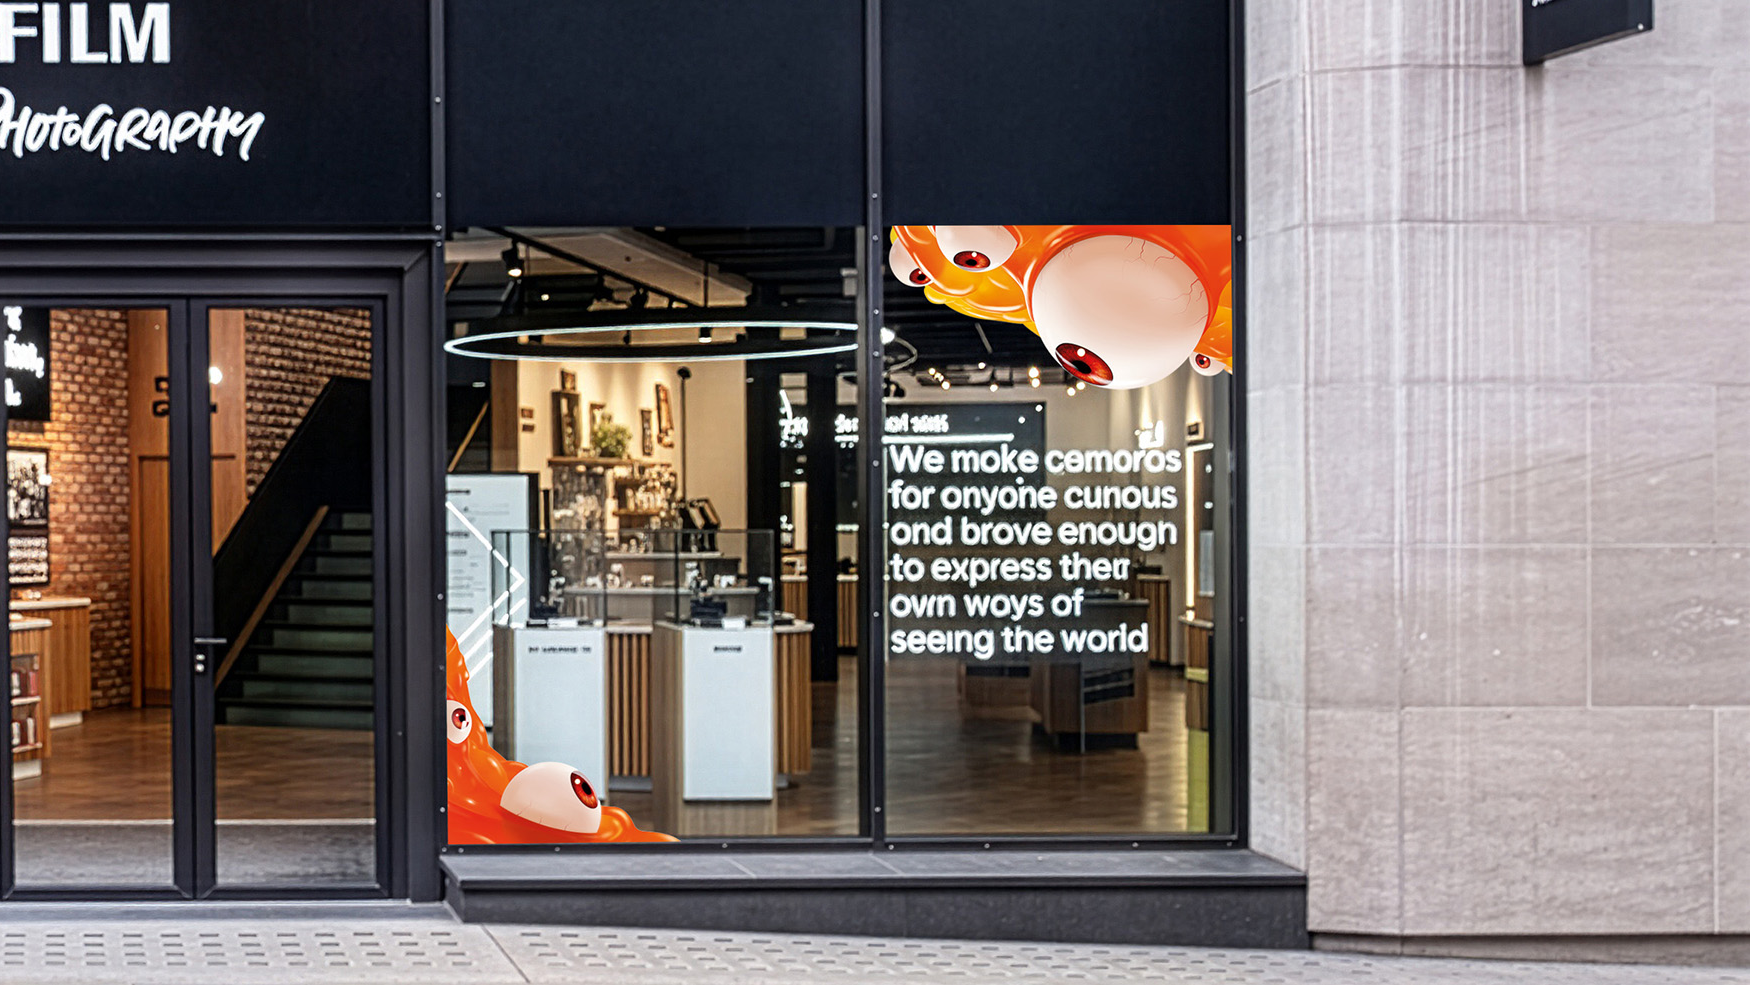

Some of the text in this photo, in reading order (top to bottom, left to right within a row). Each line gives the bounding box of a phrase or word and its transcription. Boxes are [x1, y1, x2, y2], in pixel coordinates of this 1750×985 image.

[889, 444, 945, 474] We
[888, 479, 936, 510] for
[1058, 520, 1177, 551] enough
[889, 553, 925, 582] to
[930, 557, 1052, 588] express
[1051, 588, 1084, 617] of
[1000, 625, 1055, 653] the
[1060, 622, 1149, 653] world
